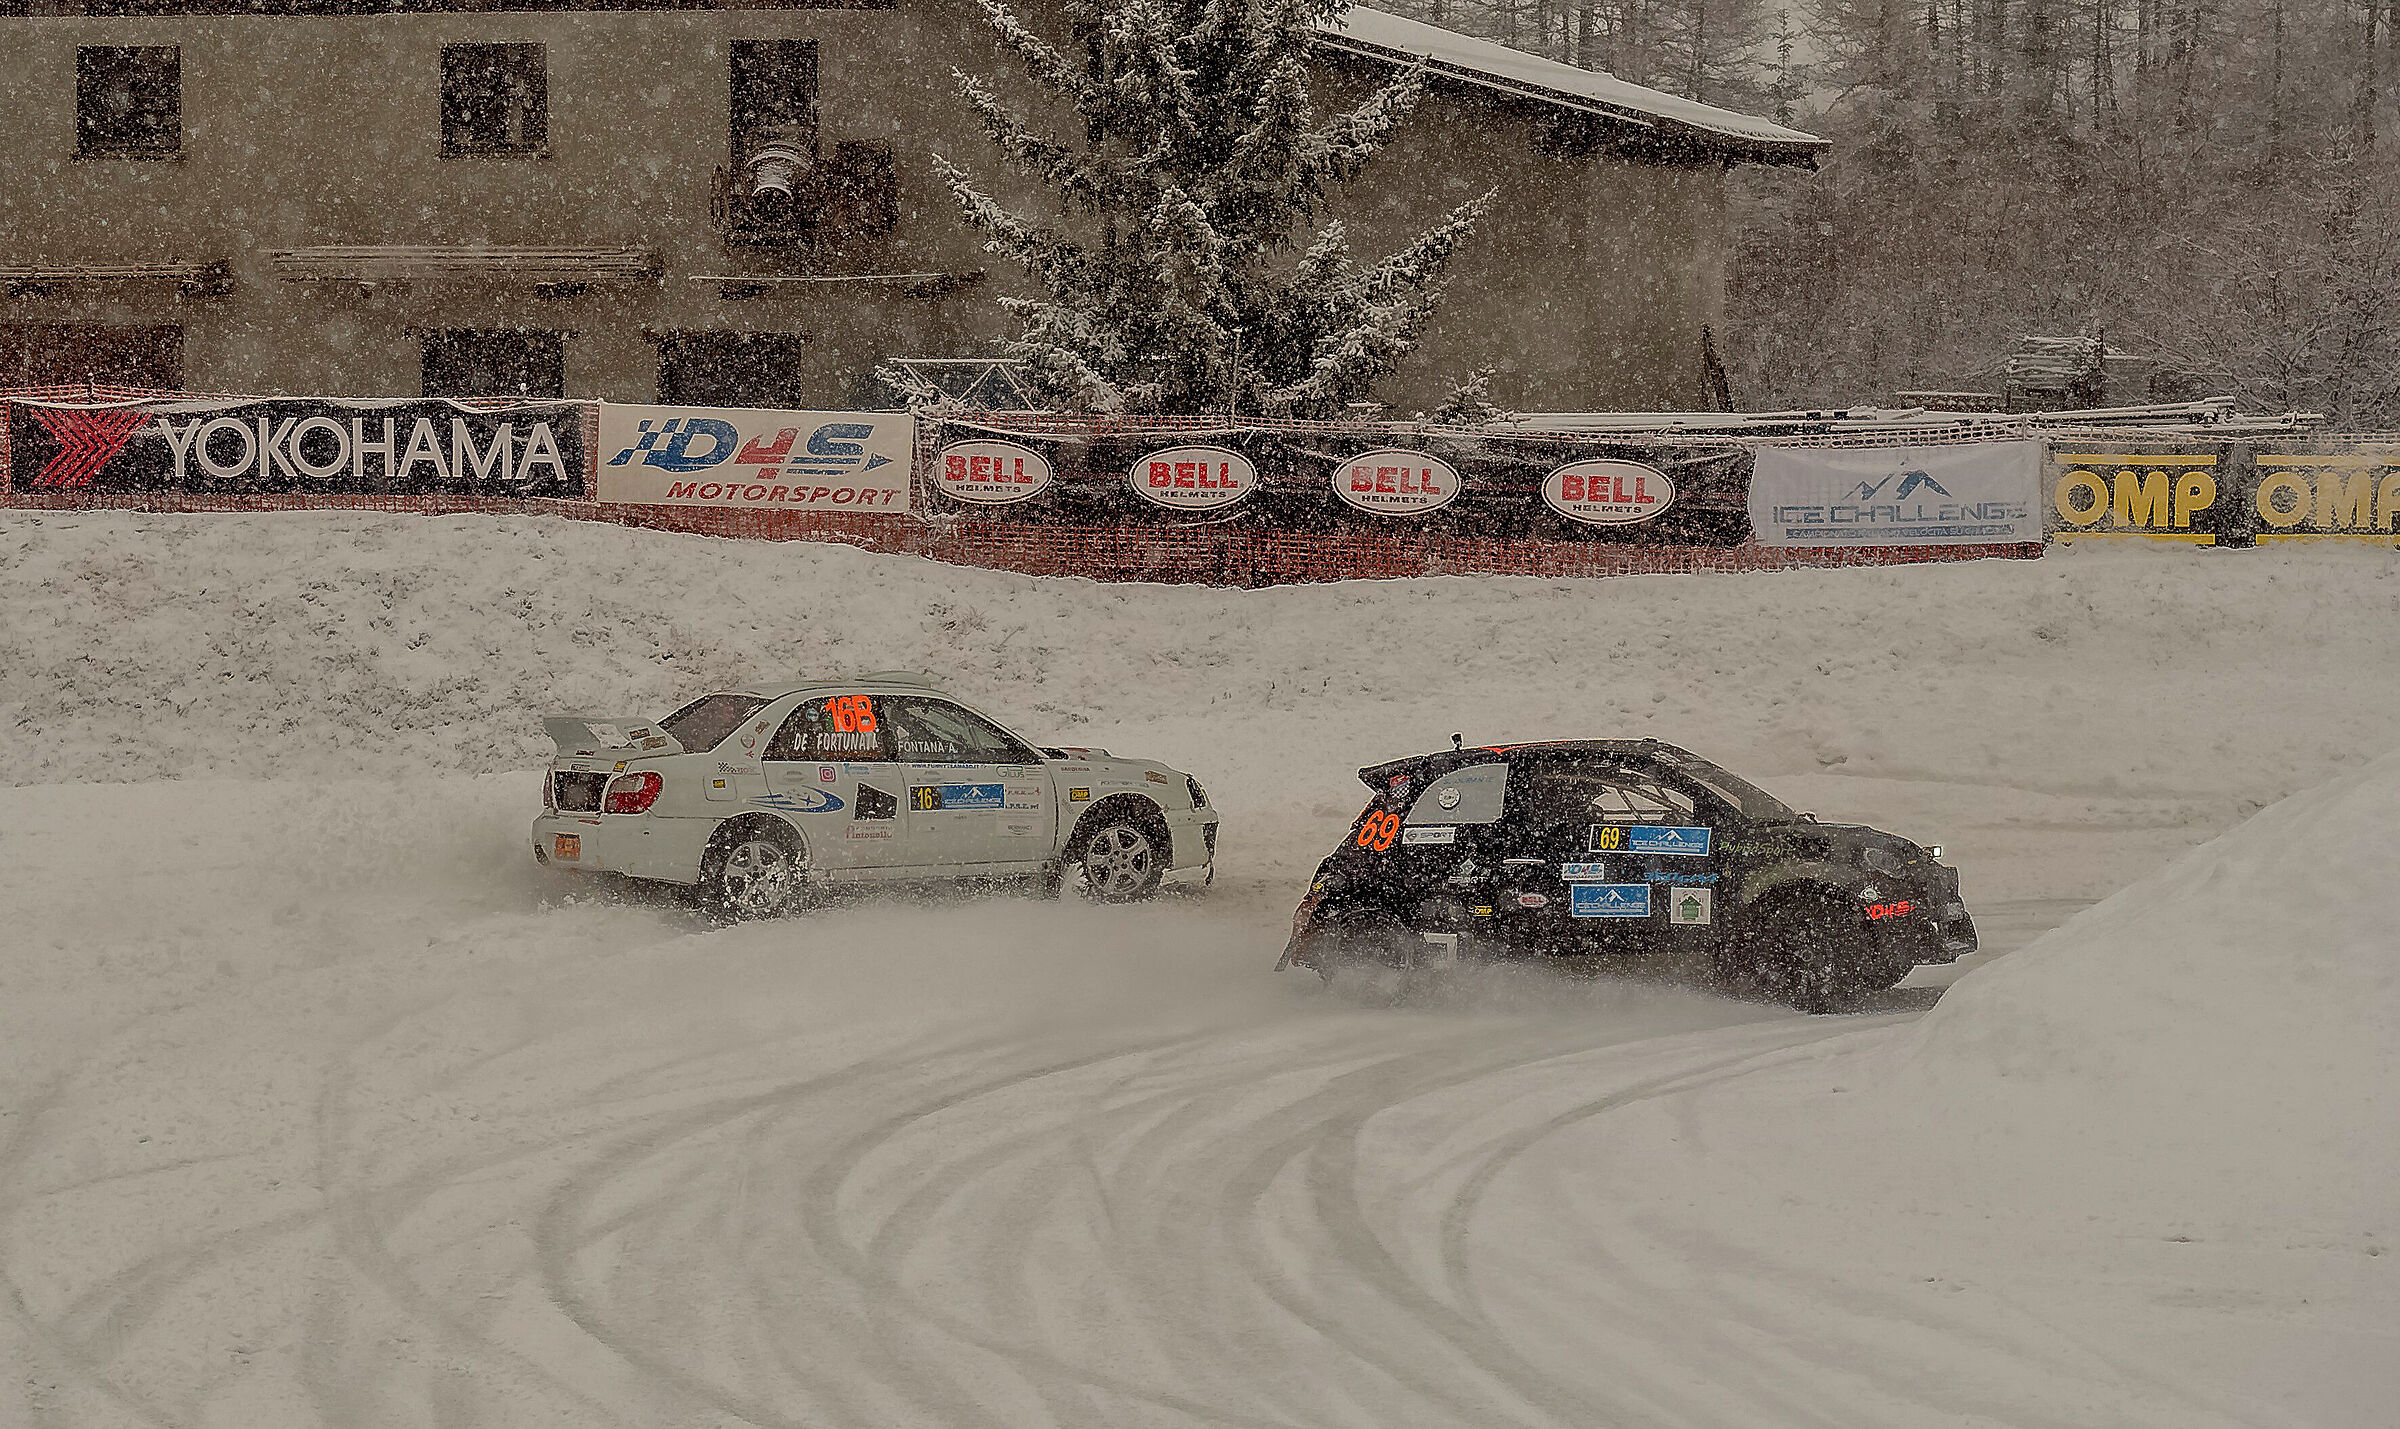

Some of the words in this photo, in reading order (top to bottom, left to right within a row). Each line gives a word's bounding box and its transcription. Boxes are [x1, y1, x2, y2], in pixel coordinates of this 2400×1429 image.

[159, 416, 567, 481] YOKOHAMA
[945, 455, 1034, 484] BELL
[1148, 461, 1240, 489] BELL
[1350, 466, 1441, 495] BELL
[666, 481, 901, 506] MOTORSPORT
[955, 485, 1022, 493] HELMETS
[1159, 490, 1227, 499] HELMETS
[1361, 495, 1428, 504] HELMETS
[1561, 475, 1655, 503] BELL
[2054, 470, 2217, 527] OMP
[2256, 471, 2400, 528] OMP
[1572, 504, 1643, 513] HELMETS
[824, 695, 877, 733] 16B
[793, 733, 809, 751] DE
[898, 741, 945, 753] FONTANA
[917, 787, 933, 809] 16
[1071, 791, 1089, 799] OMP
[1357, 810, 1400, 851] 69
[1600, 827, 1620, 849] 69
